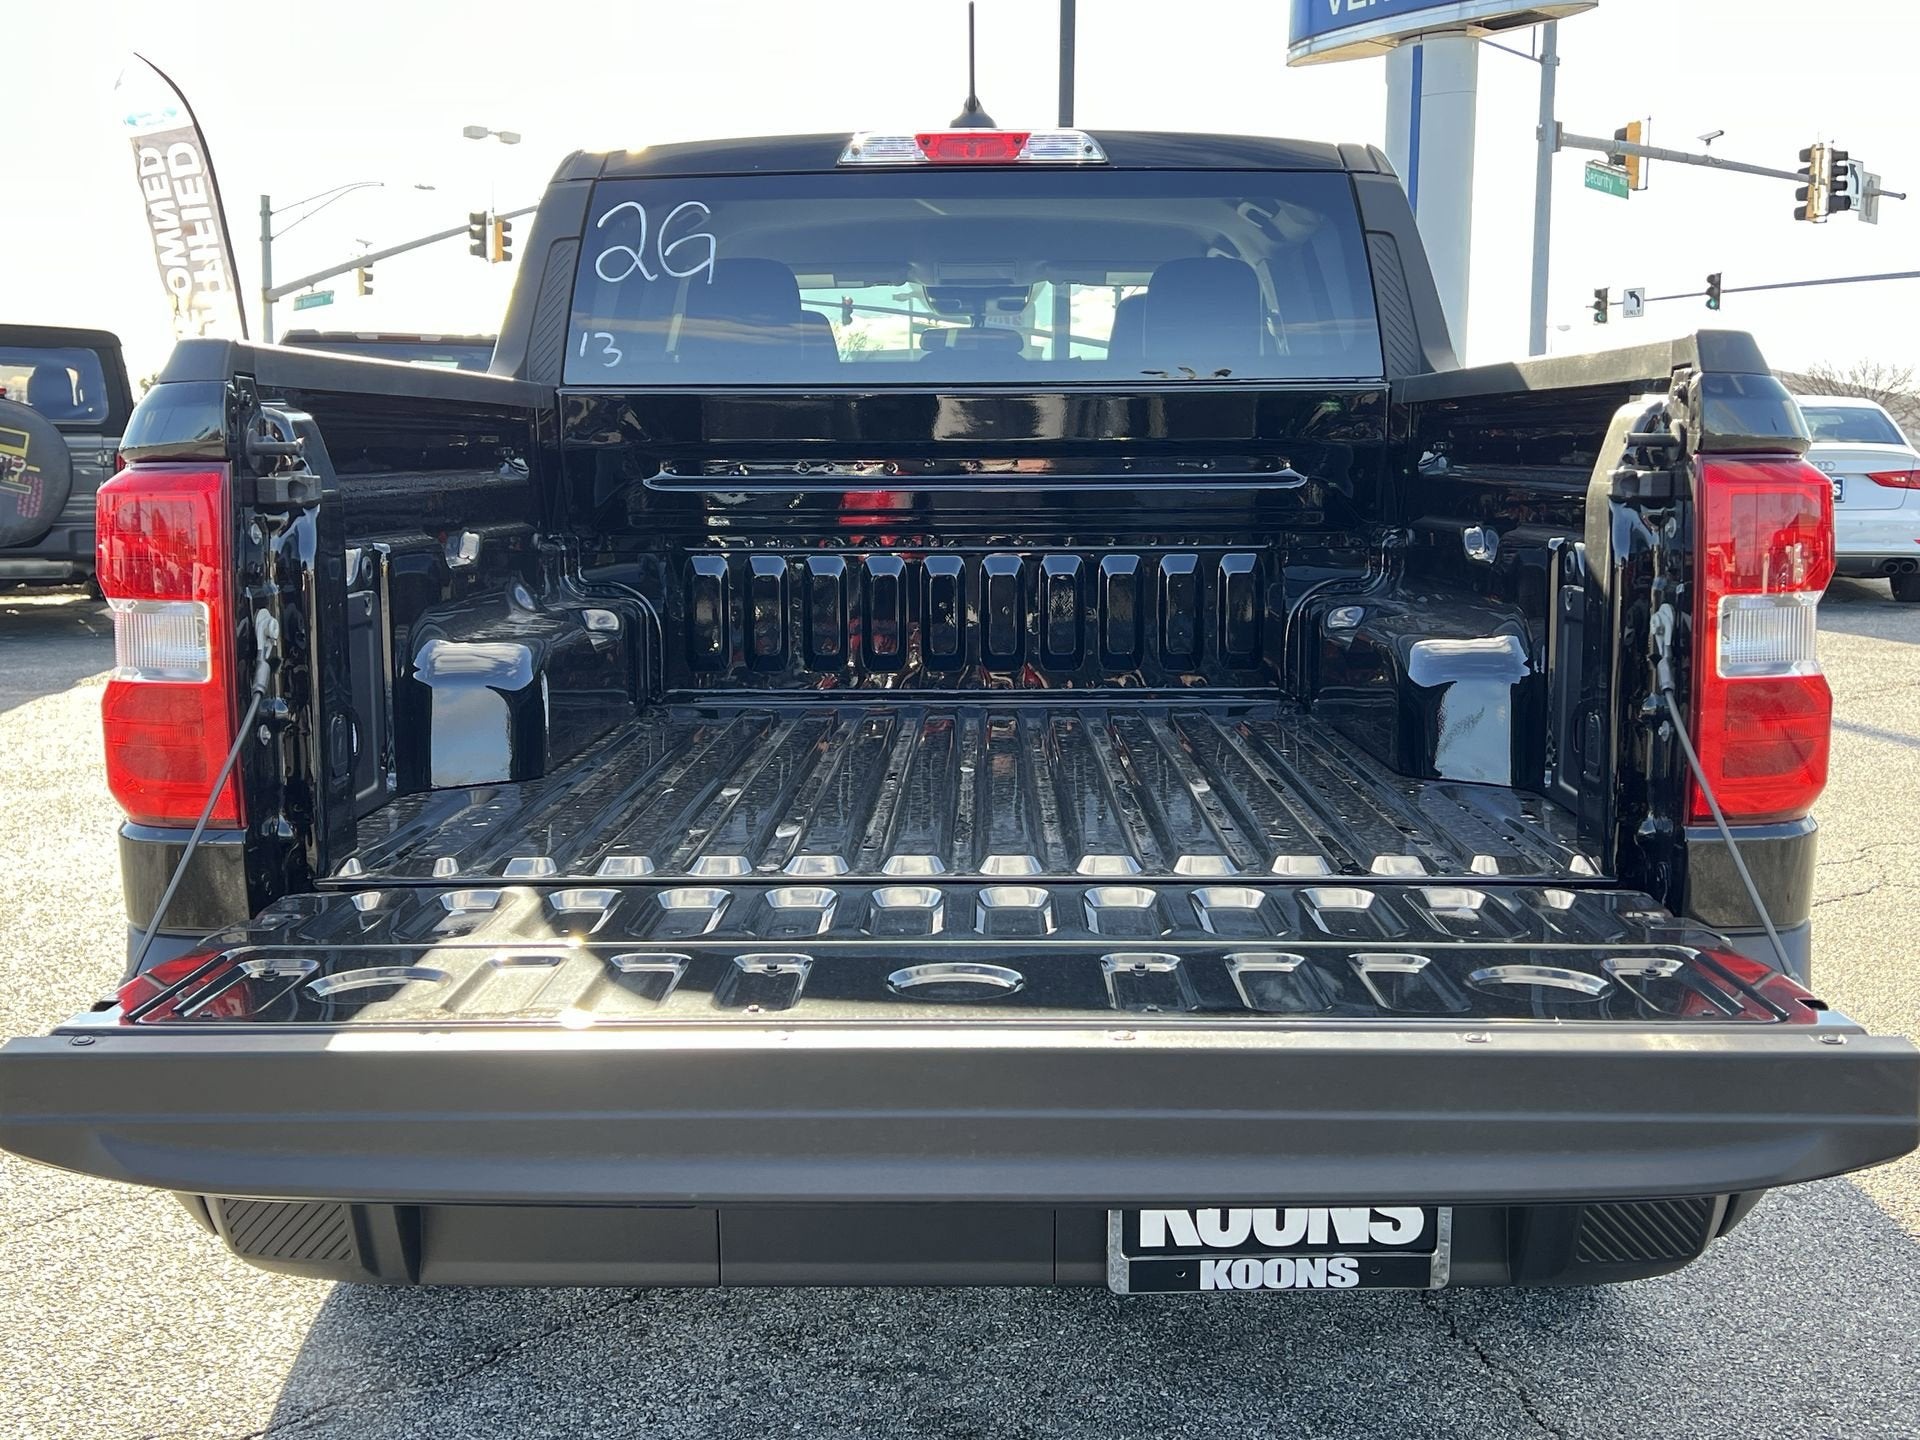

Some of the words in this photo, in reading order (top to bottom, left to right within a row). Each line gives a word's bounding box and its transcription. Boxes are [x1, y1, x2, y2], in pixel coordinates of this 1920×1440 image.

[1585, 167, 1613, 192] Security
[579, 332, 623, 368] 13
[1140, 1207, 1424, 1248] KOONS
[1200, 1257, 1359, 1290] KOONS
